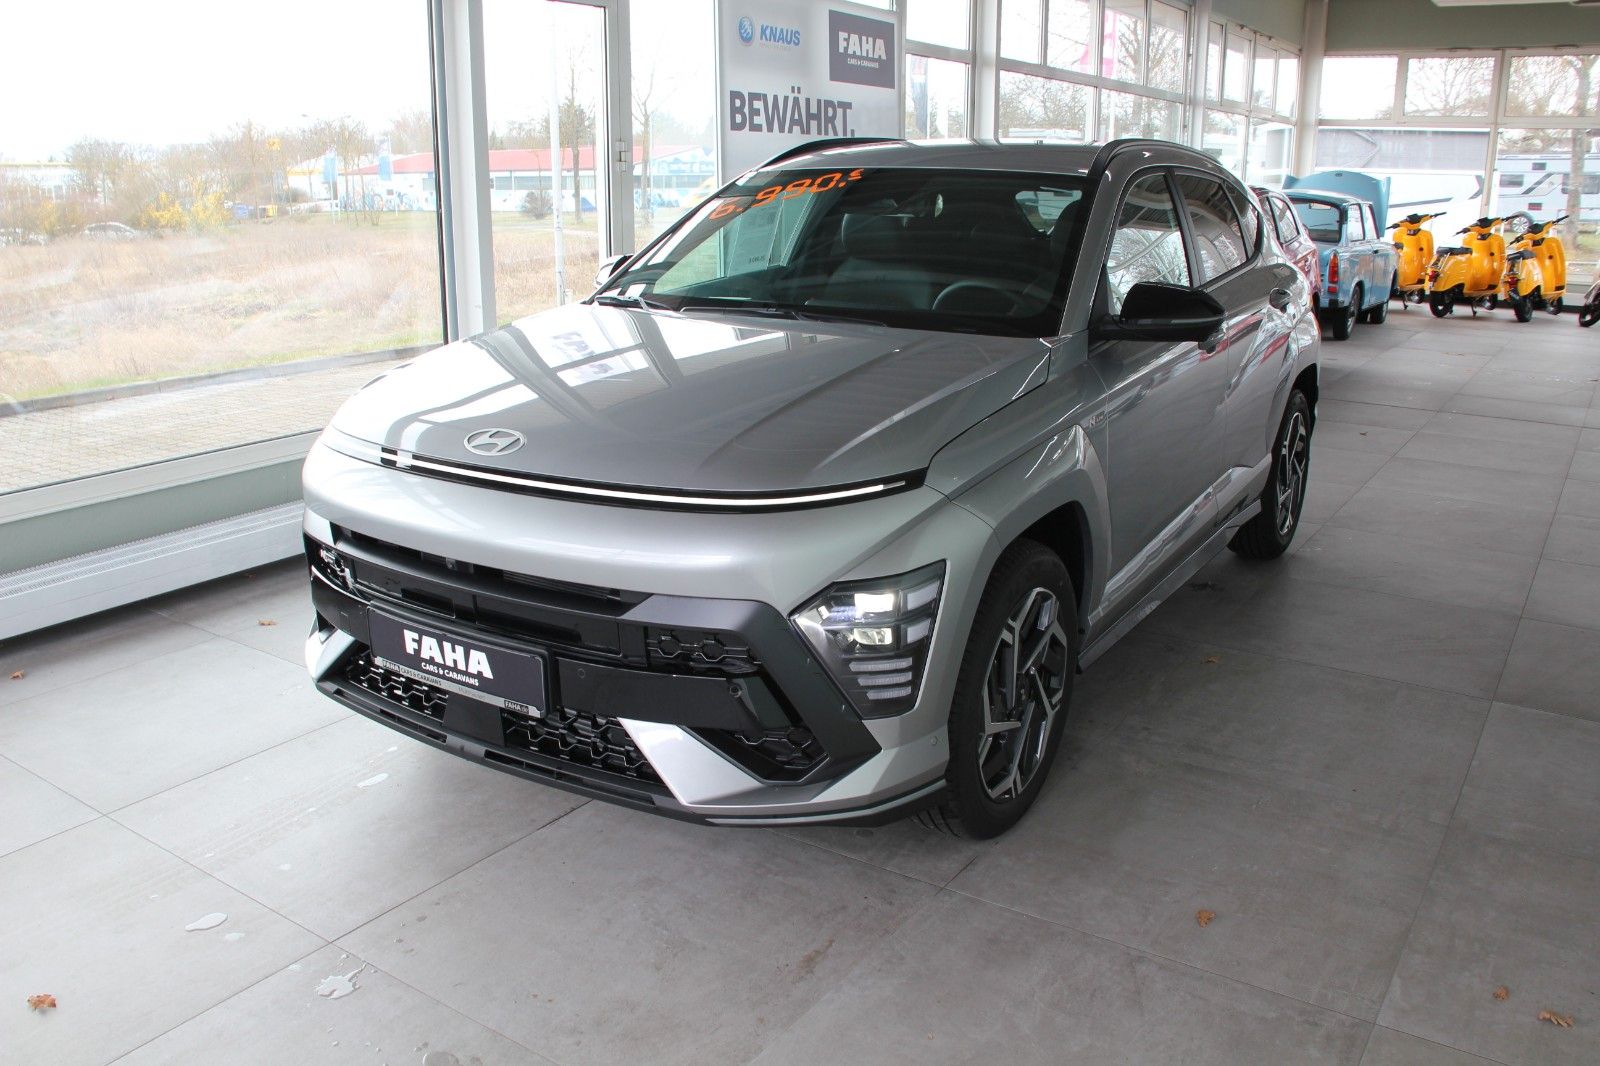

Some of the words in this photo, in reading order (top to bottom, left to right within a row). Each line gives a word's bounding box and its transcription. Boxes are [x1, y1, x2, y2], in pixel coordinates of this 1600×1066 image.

[760, 24, 801, 46] KNAUS
[838, 31, 887, 60] FAHA
[729, 86, 856, 138] BEWÄHRT.
[403, 629, 494, 679] FAHA
[421, 662, 439, 674] CARS
[444, 670, 480, 687] CARAVANS
